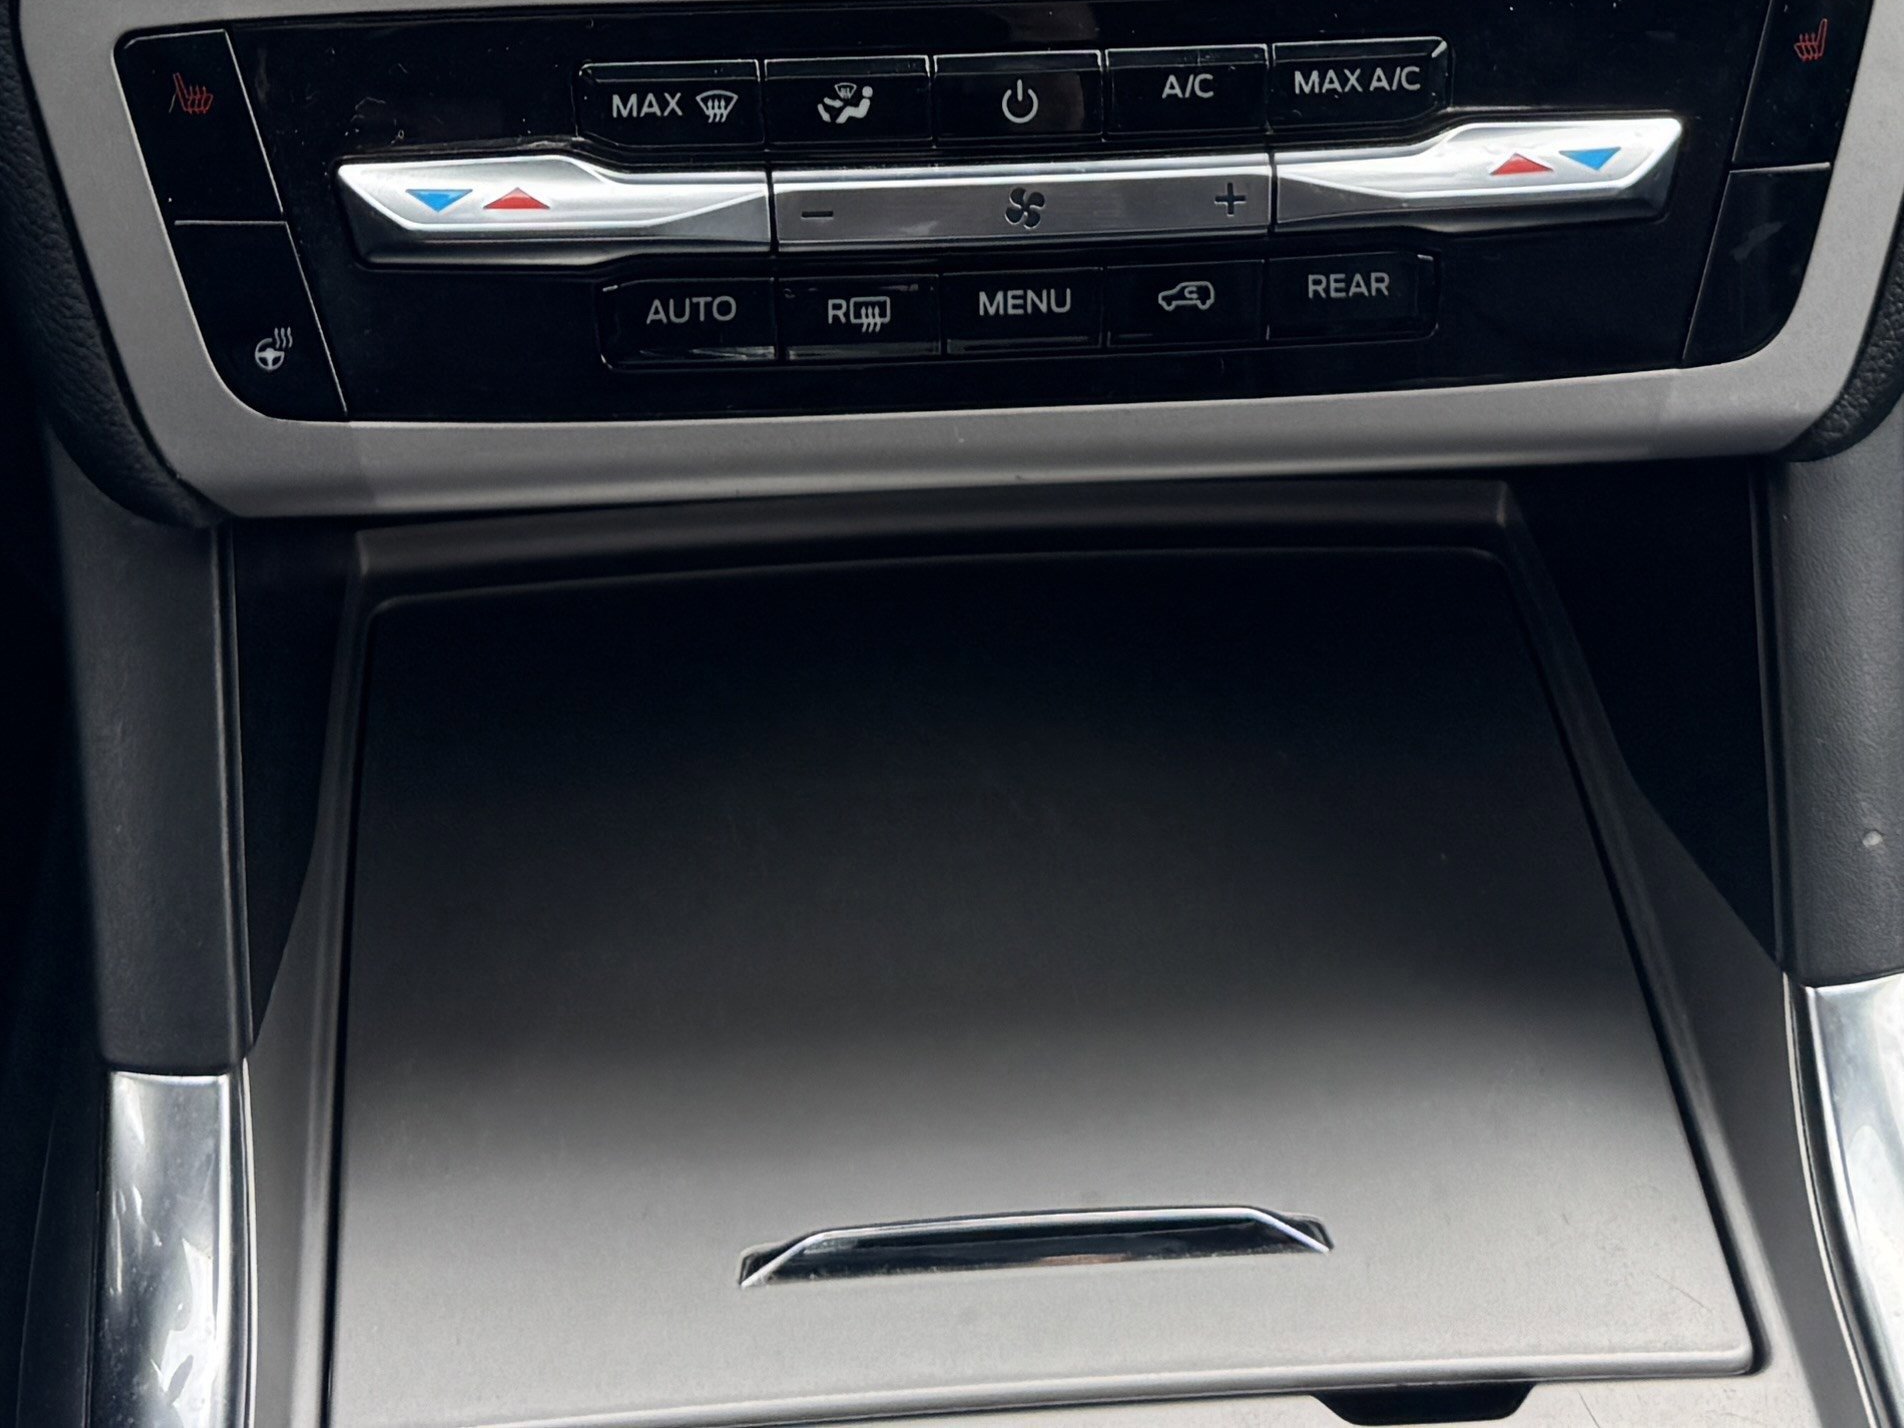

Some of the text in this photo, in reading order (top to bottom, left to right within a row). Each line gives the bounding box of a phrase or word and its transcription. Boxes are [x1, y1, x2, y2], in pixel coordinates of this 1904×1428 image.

[1161, 73, 1214, 99] A/C
[1294, 66, 1421, 95] MAX A/C
[612, 92, 683, 118] MAX
[1308, 272, 1390, 299] REAR
[646, 295, 737, 325] AUTO
[979, 288, 1071, 316] MENU
